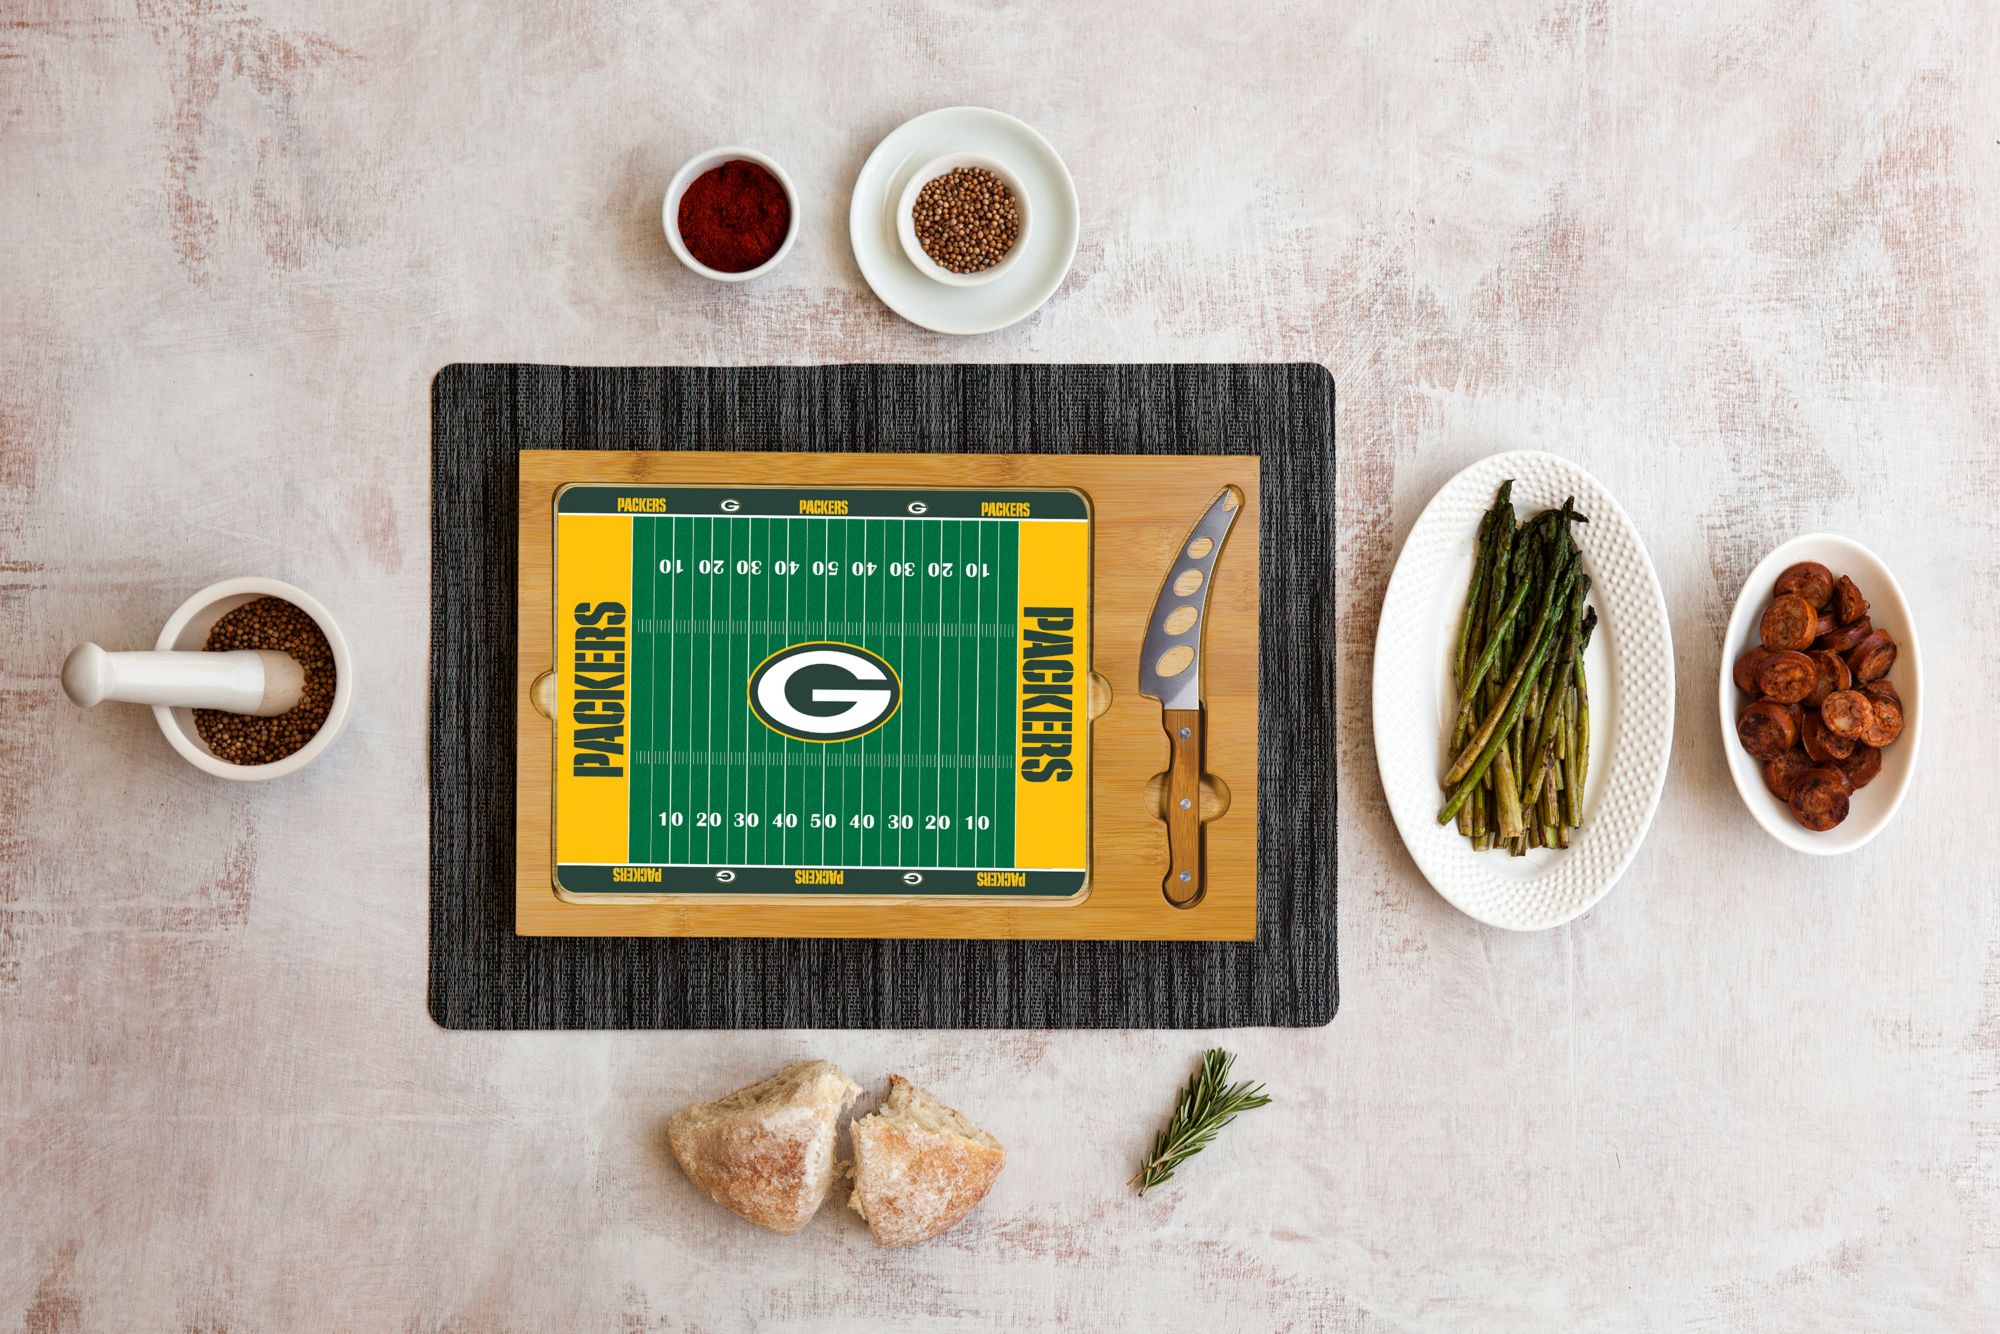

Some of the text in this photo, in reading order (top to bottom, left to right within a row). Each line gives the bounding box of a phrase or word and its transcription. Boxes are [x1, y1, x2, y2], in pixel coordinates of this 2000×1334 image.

[617, 498, 666, 512] PACKERS
[720, 499, 740, 512] G
[799, 500, 848, 514] PACKERS
[907, 502, 927, 514] G
[981, 502, 1030, 517] PACKERS
[659, 559, 990, 578] 10 20 30 40 50 40 30 20 10
[574, 602, 626, 777] PACKERS
[757, 650, 892, 734] G
[1021, 607, 1074, 782] PACKERS
[658, 811, 990, 830] 10 20 30 40 50 40 30 20 10
[612, 868, 662, 883] PACKERS
[716, 870, 736, 882] G
[795, 870, 844, 885] PACKERS
[903, 873, 923, 885] G
[977, 872, 1026, 887] PACKERS
